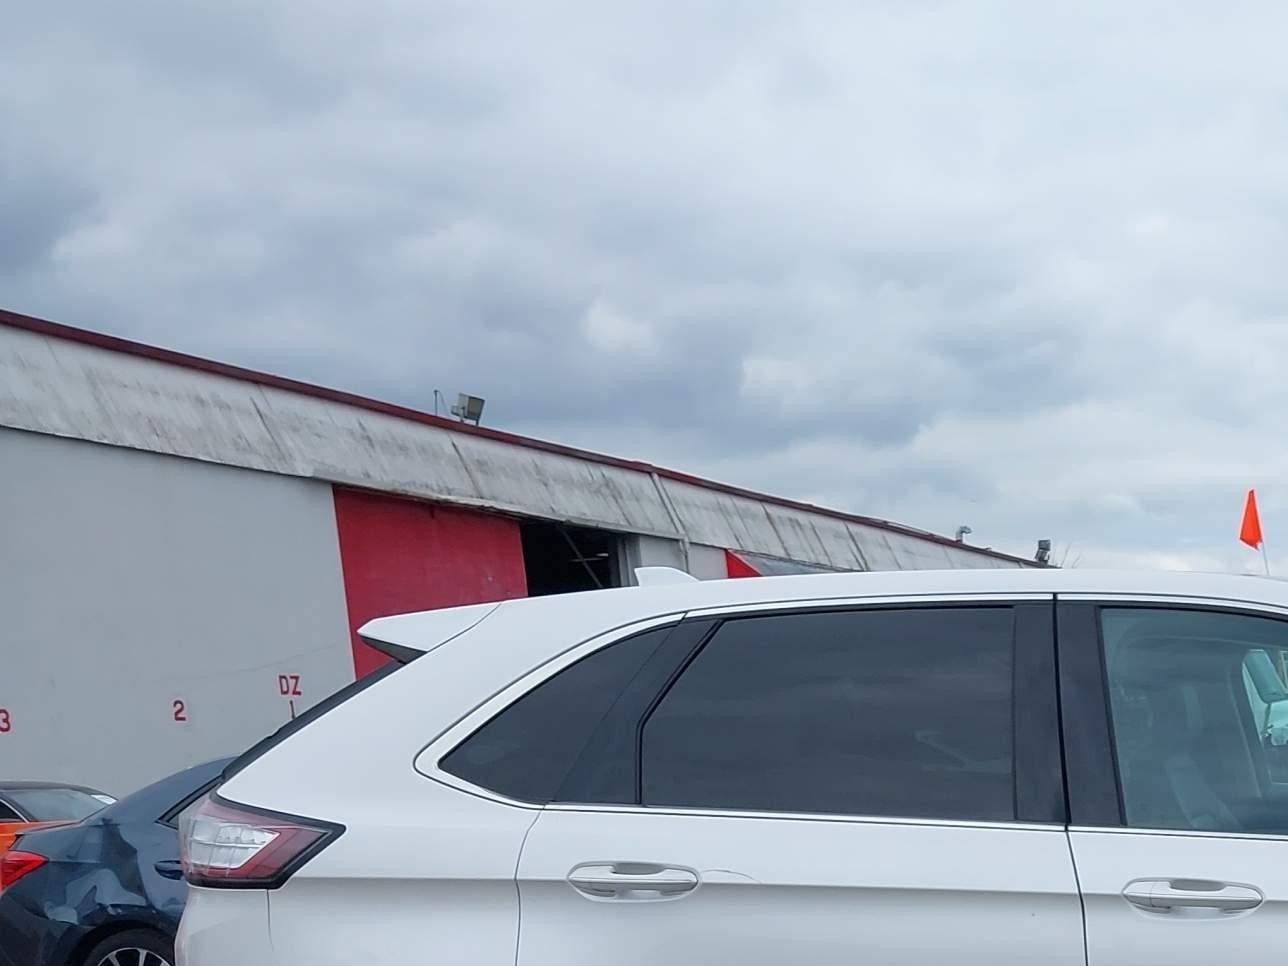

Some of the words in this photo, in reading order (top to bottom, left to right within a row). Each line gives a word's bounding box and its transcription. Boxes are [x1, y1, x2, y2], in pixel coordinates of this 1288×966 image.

[279, 675, 302, 696] DZ
[0, 709, 11, 732] 3
[172, 699, 187, 722] 2
